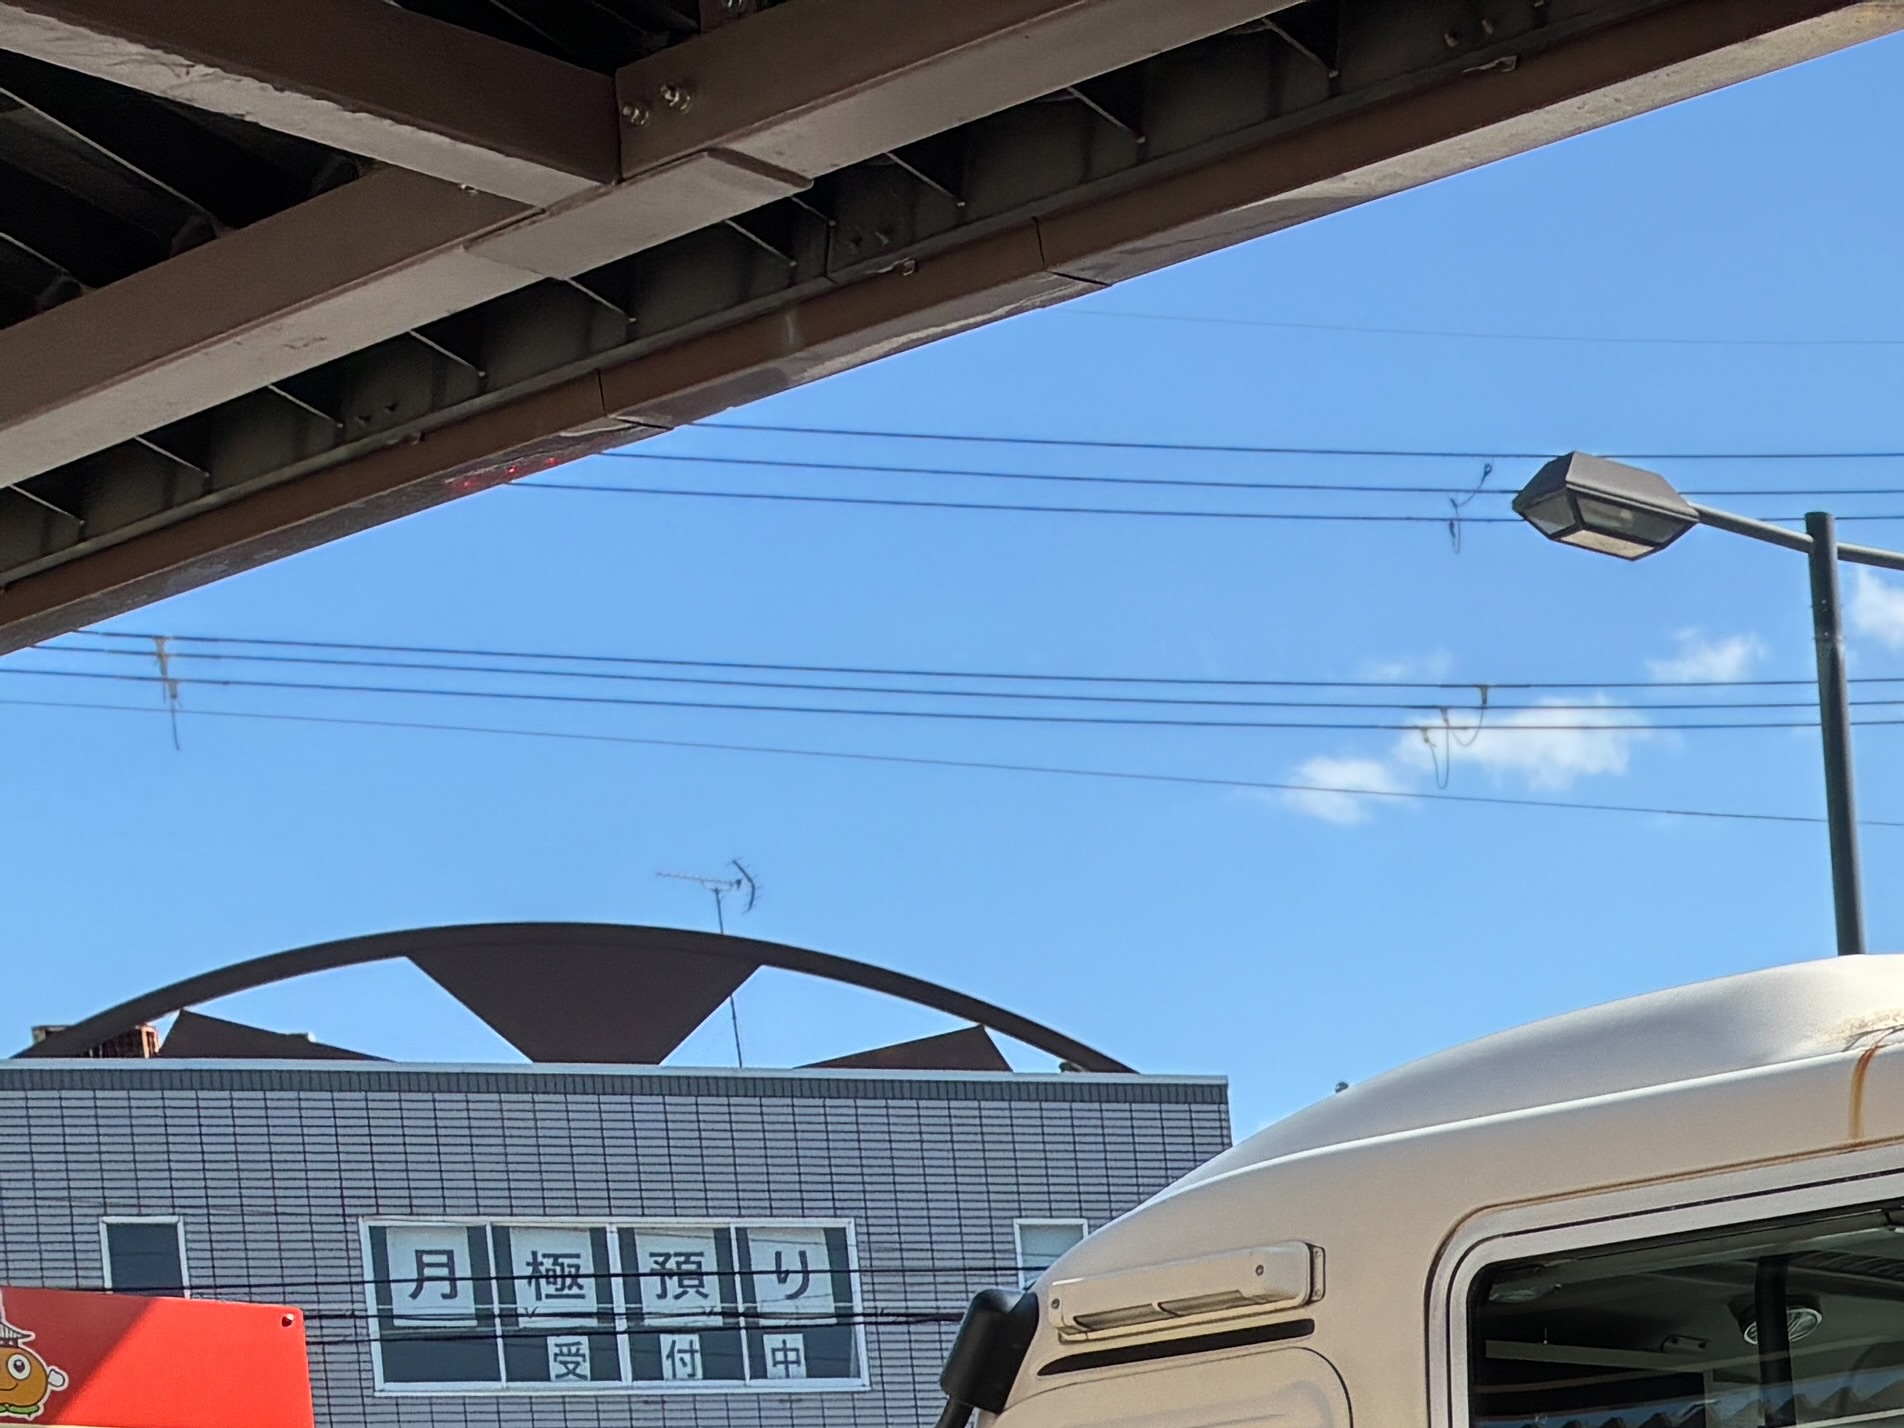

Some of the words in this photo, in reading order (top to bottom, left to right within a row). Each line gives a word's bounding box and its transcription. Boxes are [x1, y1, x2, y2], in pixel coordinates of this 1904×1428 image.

[409, 1249, 811, 1300] 月極預り
[553, 1339, 803, 1381] 受付中
